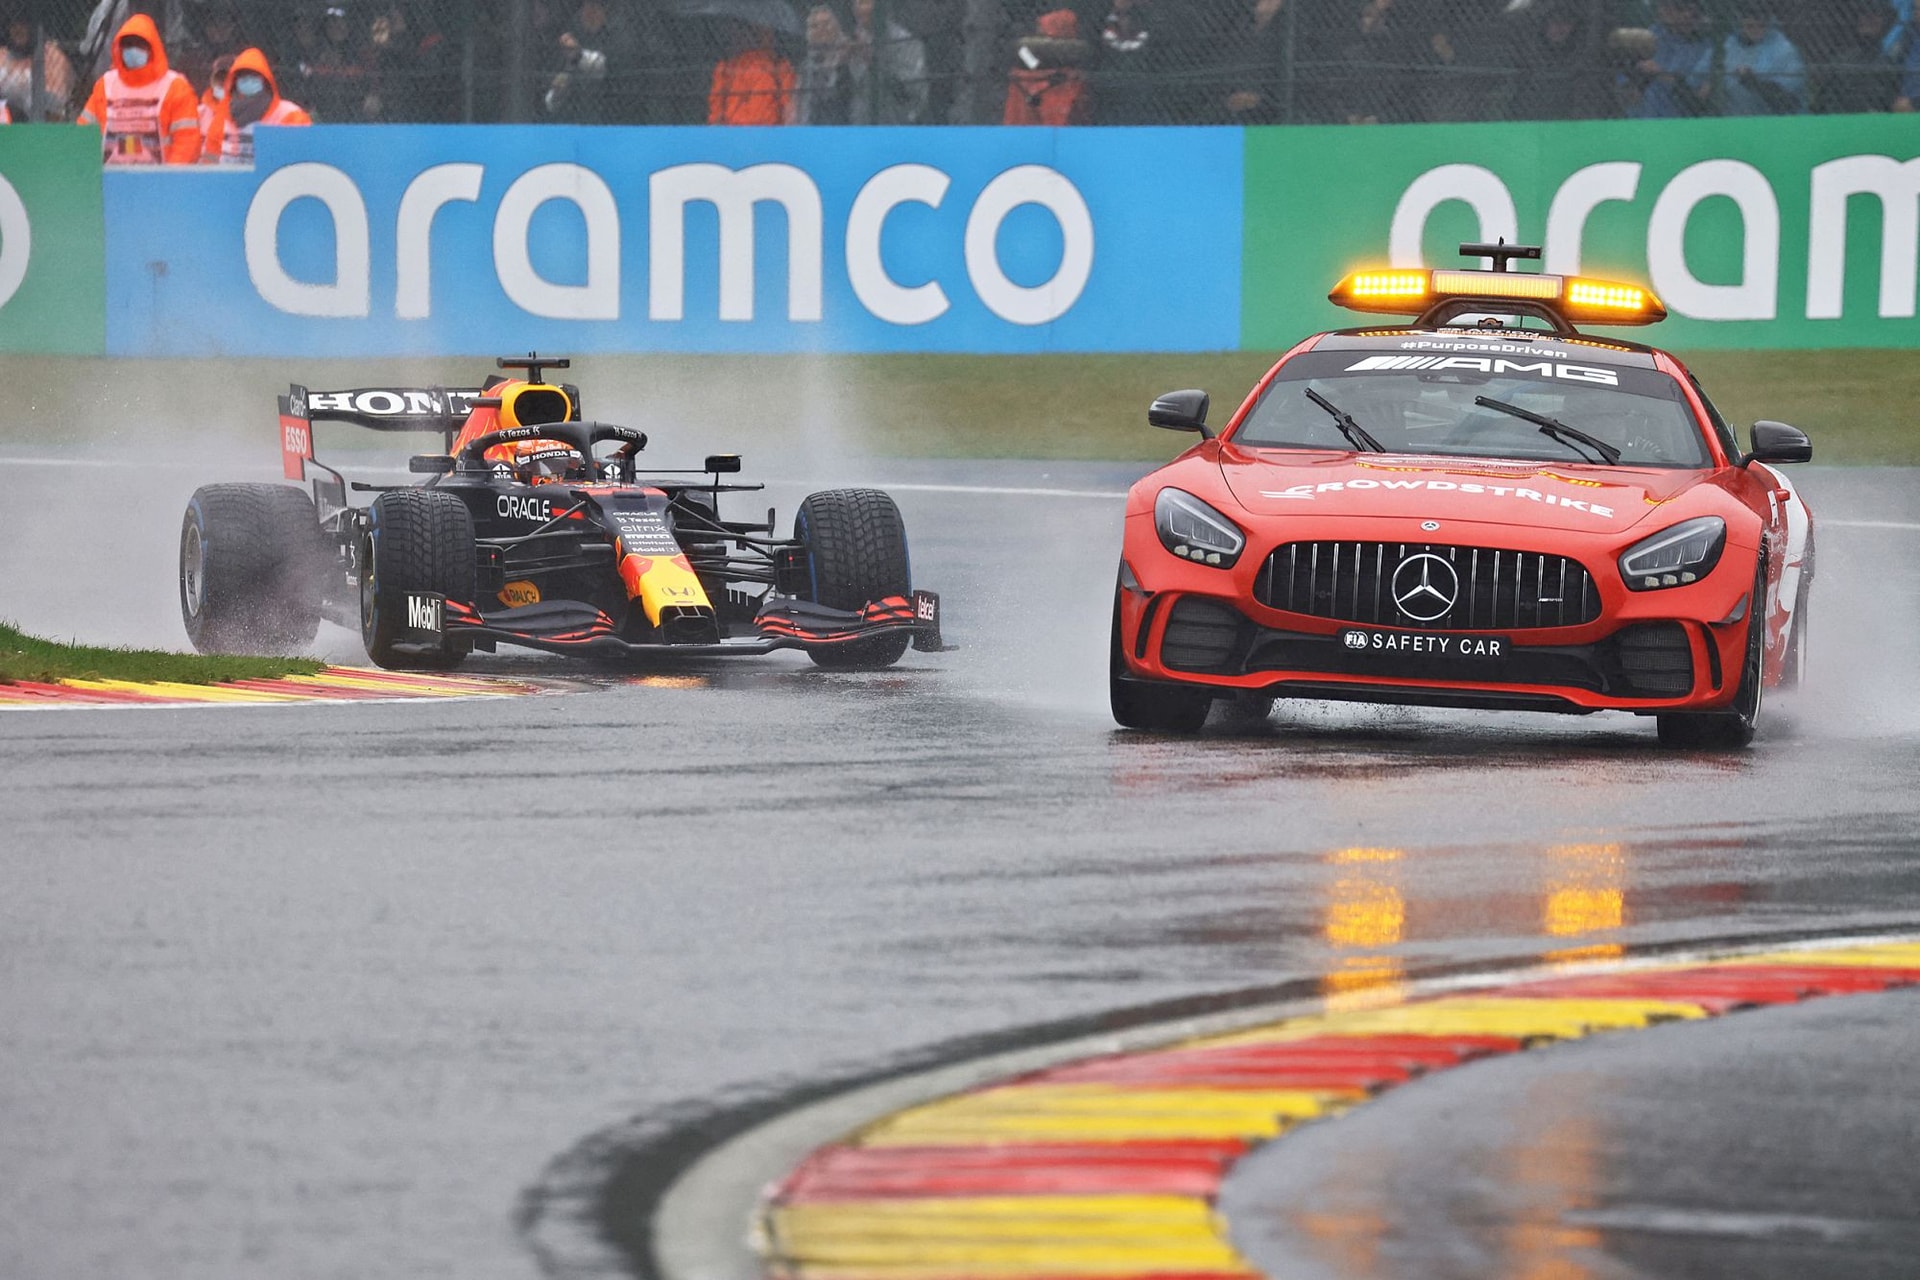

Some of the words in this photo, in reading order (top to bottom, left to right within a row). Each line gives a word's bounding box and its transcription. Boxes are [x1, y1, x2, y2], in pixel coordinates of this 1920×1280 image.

[244, 161, 1094, 326] aramco
[1400, 340, 1568, 358] #PurposeDriven
[1433, 357, 1619, 386] AMG
[532, 450, 568, 461] HONDA
[497, 495, 551, 522] ORACLE
[1283, 479, 1614, 519] CROWDSTRIKE
[408, 595, 435, 631] Mobil
[1344, 630, 1369, 649] FIA
[1372, 632, 1450, 653] SAFETY
[1459, 638, 1501, 656] CAR
